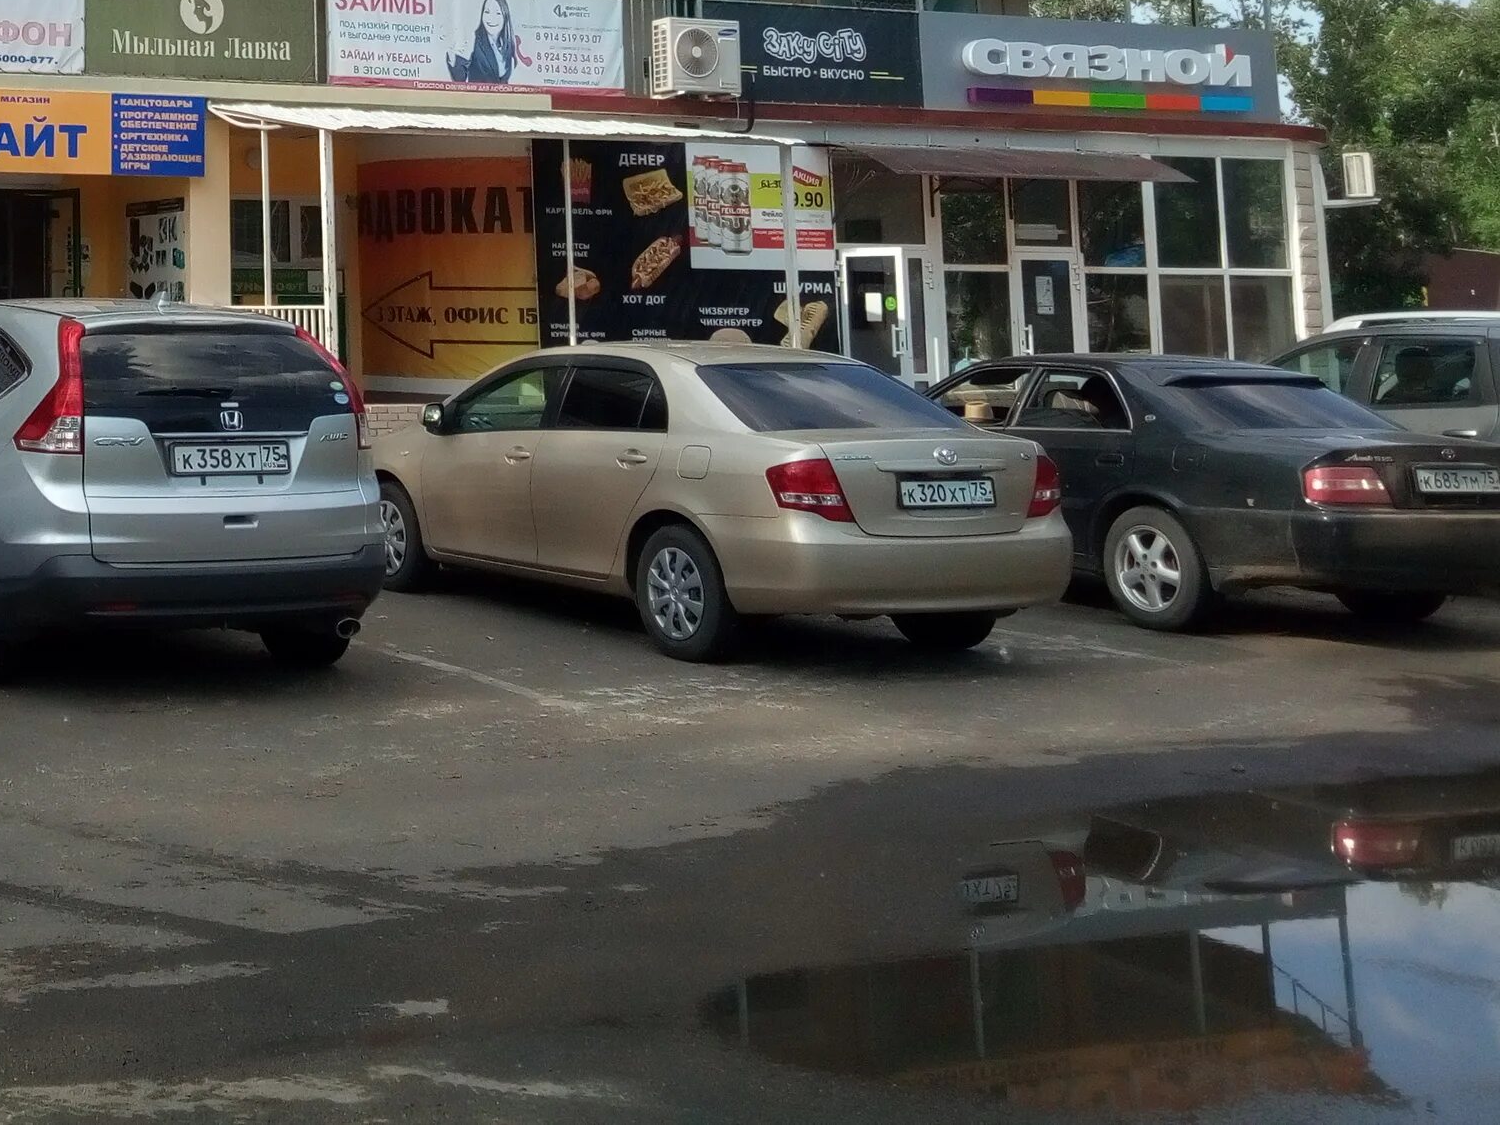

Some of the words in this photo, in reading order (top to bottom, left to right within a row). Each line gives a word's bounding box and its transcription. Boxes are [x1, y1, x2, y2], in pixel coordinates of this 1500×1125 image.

[358, 22, 390, 31] низкий
[348, 32, 391, 43] выгодные
[393, 34, 431, 44] условия
[543, 32, 560, 41] 914
[561, 33, 578, 42] 519
[580, 34, 590, 43] 93
[592, 35, 602, 44] 07
[111, 29, 215, 58] Мыльная
[224, 38, 291, 61] Лавка
[340, 49, 375, 62] ЗАЙДИ
[377, 54, 384, 62] и
[386, 51, 432, 65] УБЕДИСЬ
[544, 52, 560, 62] 924
[562, 53, 578, 62] 573
[580, 54, 591, 63] 34
[544, 64, 560, 74] 914
[562, 65, 578, 75] 366
[581, 66, 592, 75] 42
[594, 66, 605, 76] 07
[762, 65, 811, 78] БЫСТРО
[820, 67, 865, 81] ВКУСНО
[0, 95, 51, 104] МАГАЗИН
[120, 98, 193, 108] КАНЦТОВАРЫ
[120, 111, 199, 121] ПРОГРАММНОЕ
[120, 120, 197, 130] ОБЕСПЕЧЕНИЕ
[120, 132, 189, 142] ОРГТЕХНИКА
[120, 143, 169, 153] ДЕТСКИЕ
[120, 152, 202, 163] РАЗВИВАЮЩИЕ
[618, 153, 666, 167] ДЕНЕР
[120, 162, 150, 171] ИГРЫ
[793, 169, 820, 188] АКЦИЯ
[357, 187, 533, 243] АДВОКАТ
[545, 207, 594, 216] КАРТФЕЛЬ
[595, 208, 613, 216] ФРИ
[551, 242, 590, 250] НАГТСЫ
[773, 281, 833, 295] ШУРМА
[622, 294, 643, 304] ХОТ
[646, 295, 667, 306] ДОГ
[444, 306, 509, 324] ОФИС
[699, 306, 750, 316] ЧИЗБУРГЕР
[700, 318, 763, 328] ЧИКЕНБУРГЕР
[631, 328, 667, 337] СЫРНЫЕ
[182, 448, 257, 470] К358ХТ
[262, 446, 282, 463] 75
[907, 483, 968, 504] К320ХТ
[970, 482, 988, 496] 75
